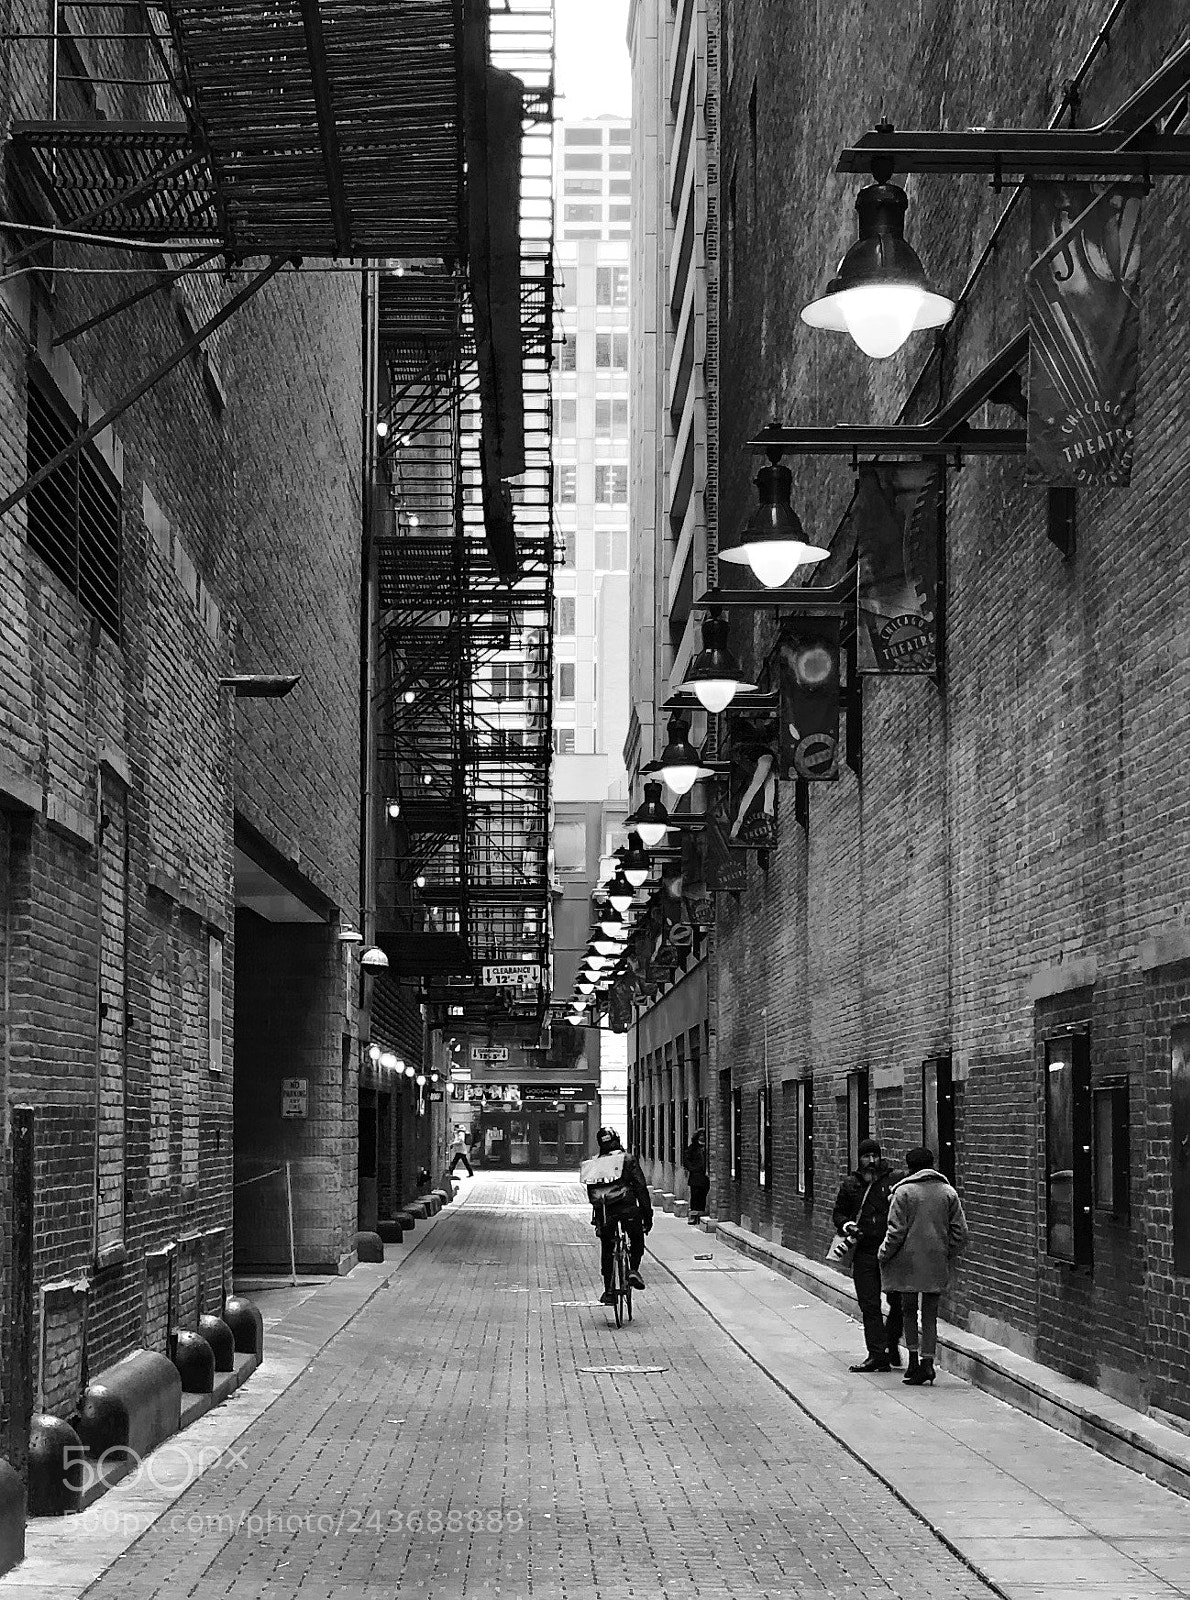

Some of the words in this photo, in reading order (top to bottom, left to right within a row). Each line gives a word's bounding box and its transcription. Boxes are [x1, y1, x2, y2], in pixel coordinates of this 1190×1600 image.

[1061, 400, 1121, 434] CHICAGO
[881, 616, 924, 640] CHICAGO
[882, 632, 936, 660] THEATRE
[492, 966, 531, 975] CLEARANCE
